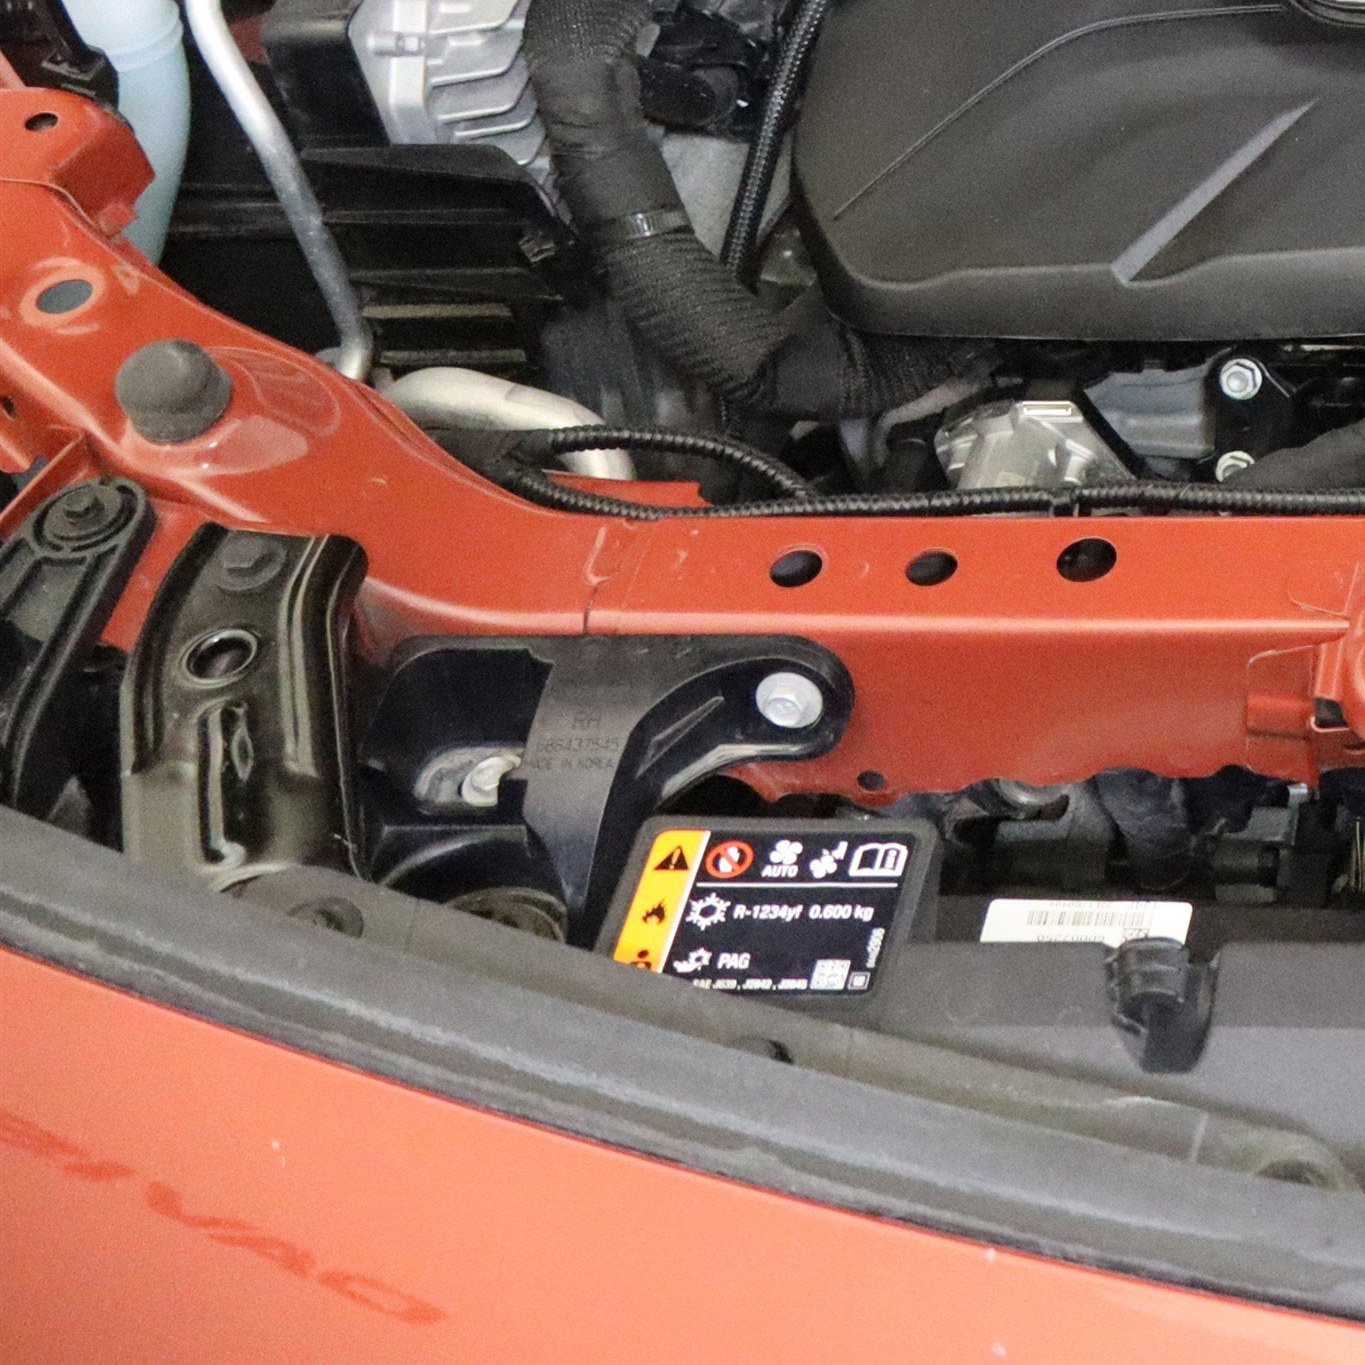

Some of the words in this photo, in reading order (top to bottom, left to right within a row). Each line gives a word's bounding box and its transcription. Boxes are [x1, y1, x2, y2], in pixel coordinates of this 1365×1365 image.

[761, 864, 799, 878] AUTO
[733, 903, 802, 922] R-1234yf
[809, 904, 852, 920] 0.600
[854, 904, 875, 923] kg
[717, 952, 751, 970] PAG
